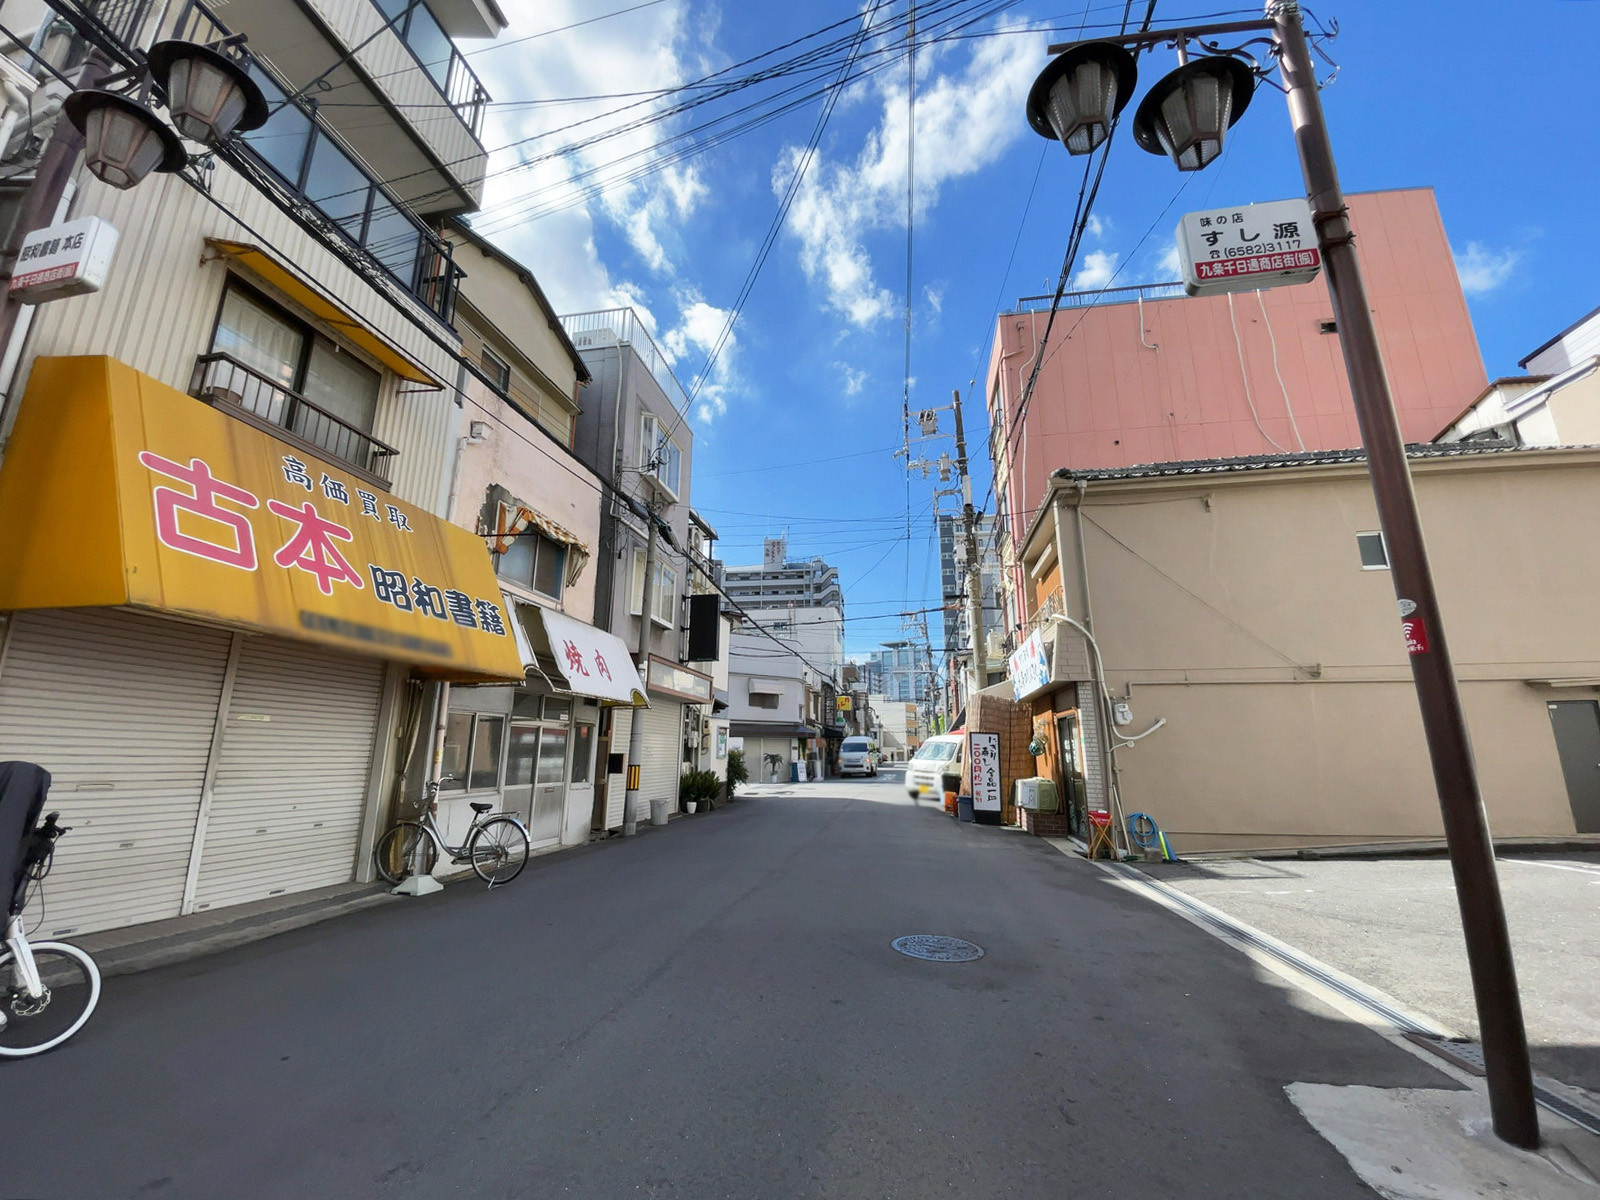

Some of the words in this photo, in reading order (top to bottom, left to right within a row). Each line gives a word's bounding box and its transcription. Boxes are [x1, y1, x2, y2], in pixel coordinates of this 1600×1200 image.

[1199, 213, 1243, 227] 味の店
[1201, 221, 1300, 246] すし源
[1224, 240, 1301, 259] (6582)3117
[282, 455, 413, 533] 高価買取
[138, 450, 366, 596] 古本
[367, 563, 507, 637] 昭和書籍
[562, 639, 612, 682] 焼肉
